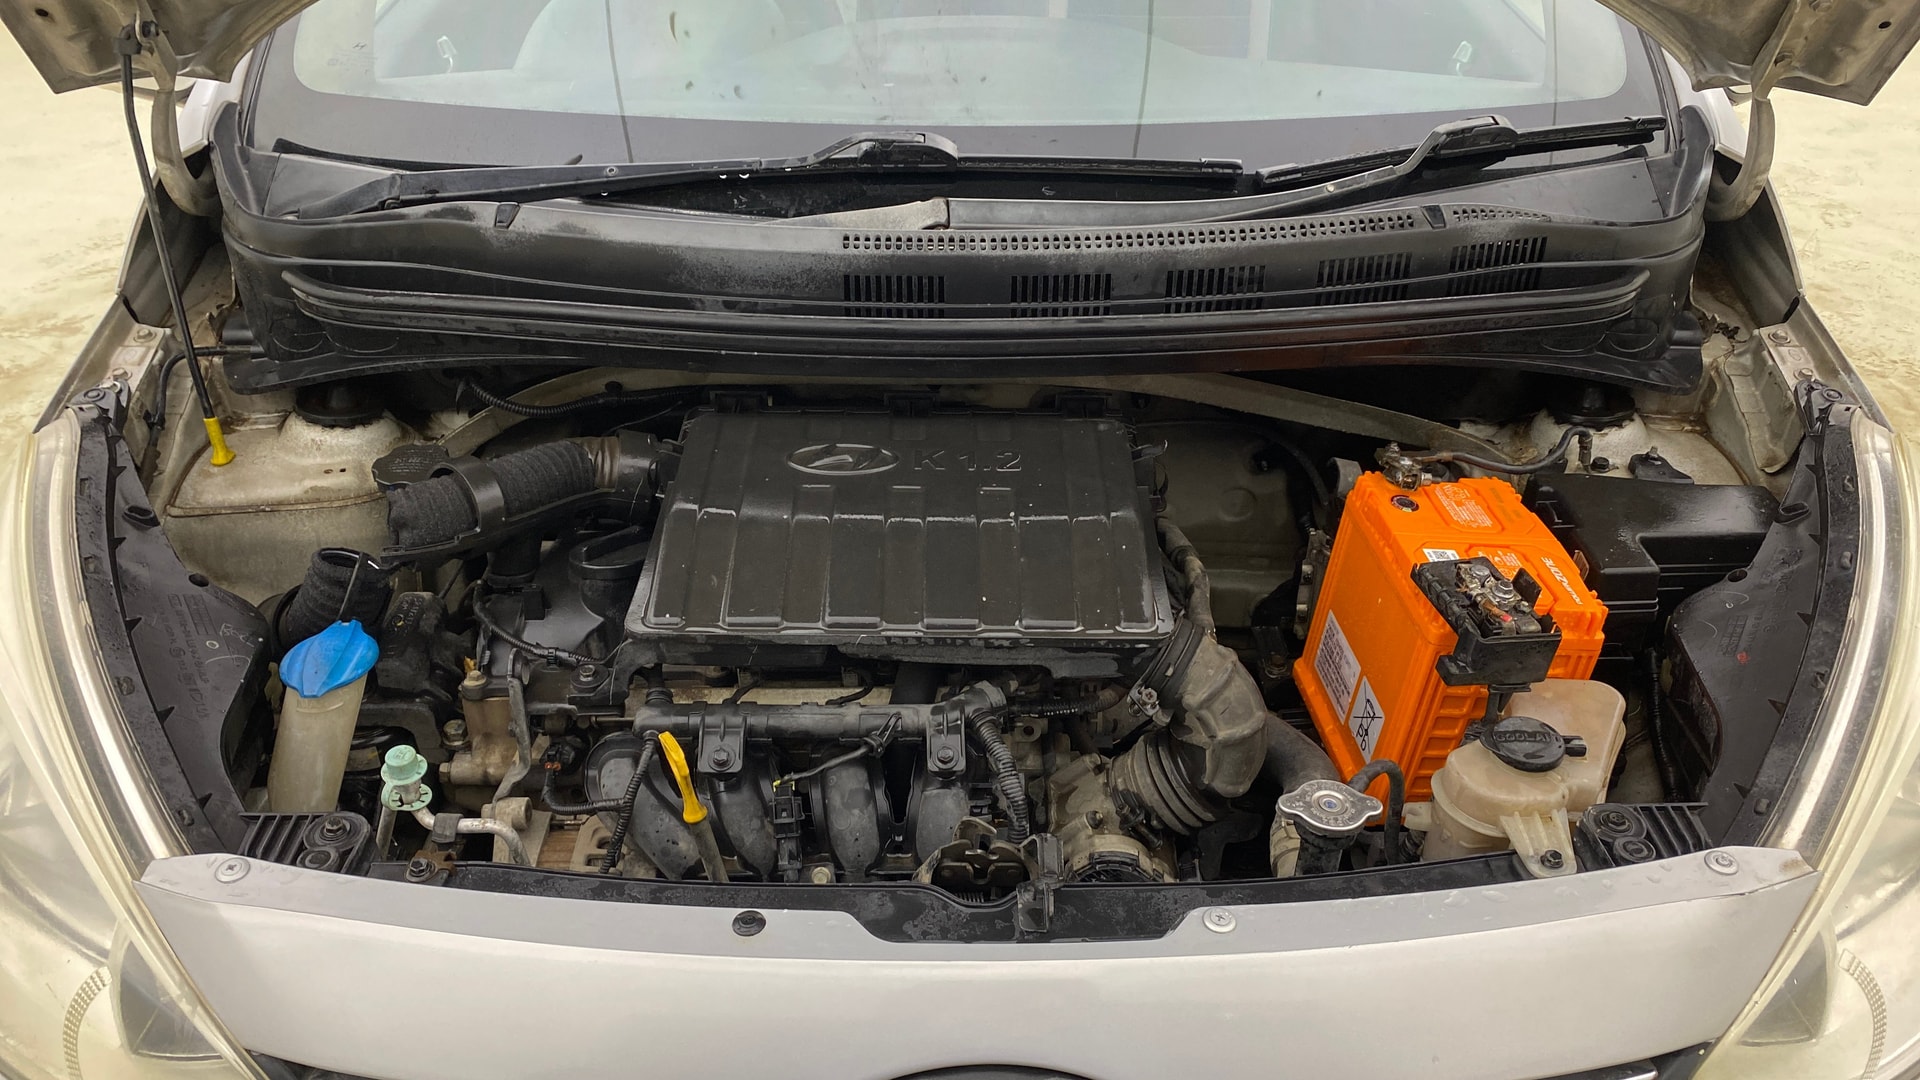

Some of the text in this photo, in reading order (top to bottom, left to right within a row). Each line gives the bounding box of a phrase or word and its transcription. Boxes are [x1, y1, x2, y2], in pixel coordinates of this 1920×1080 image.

[913, 450, 1022, 472] K 1.2
[1495, 732, 1552, 743] COOLAN
